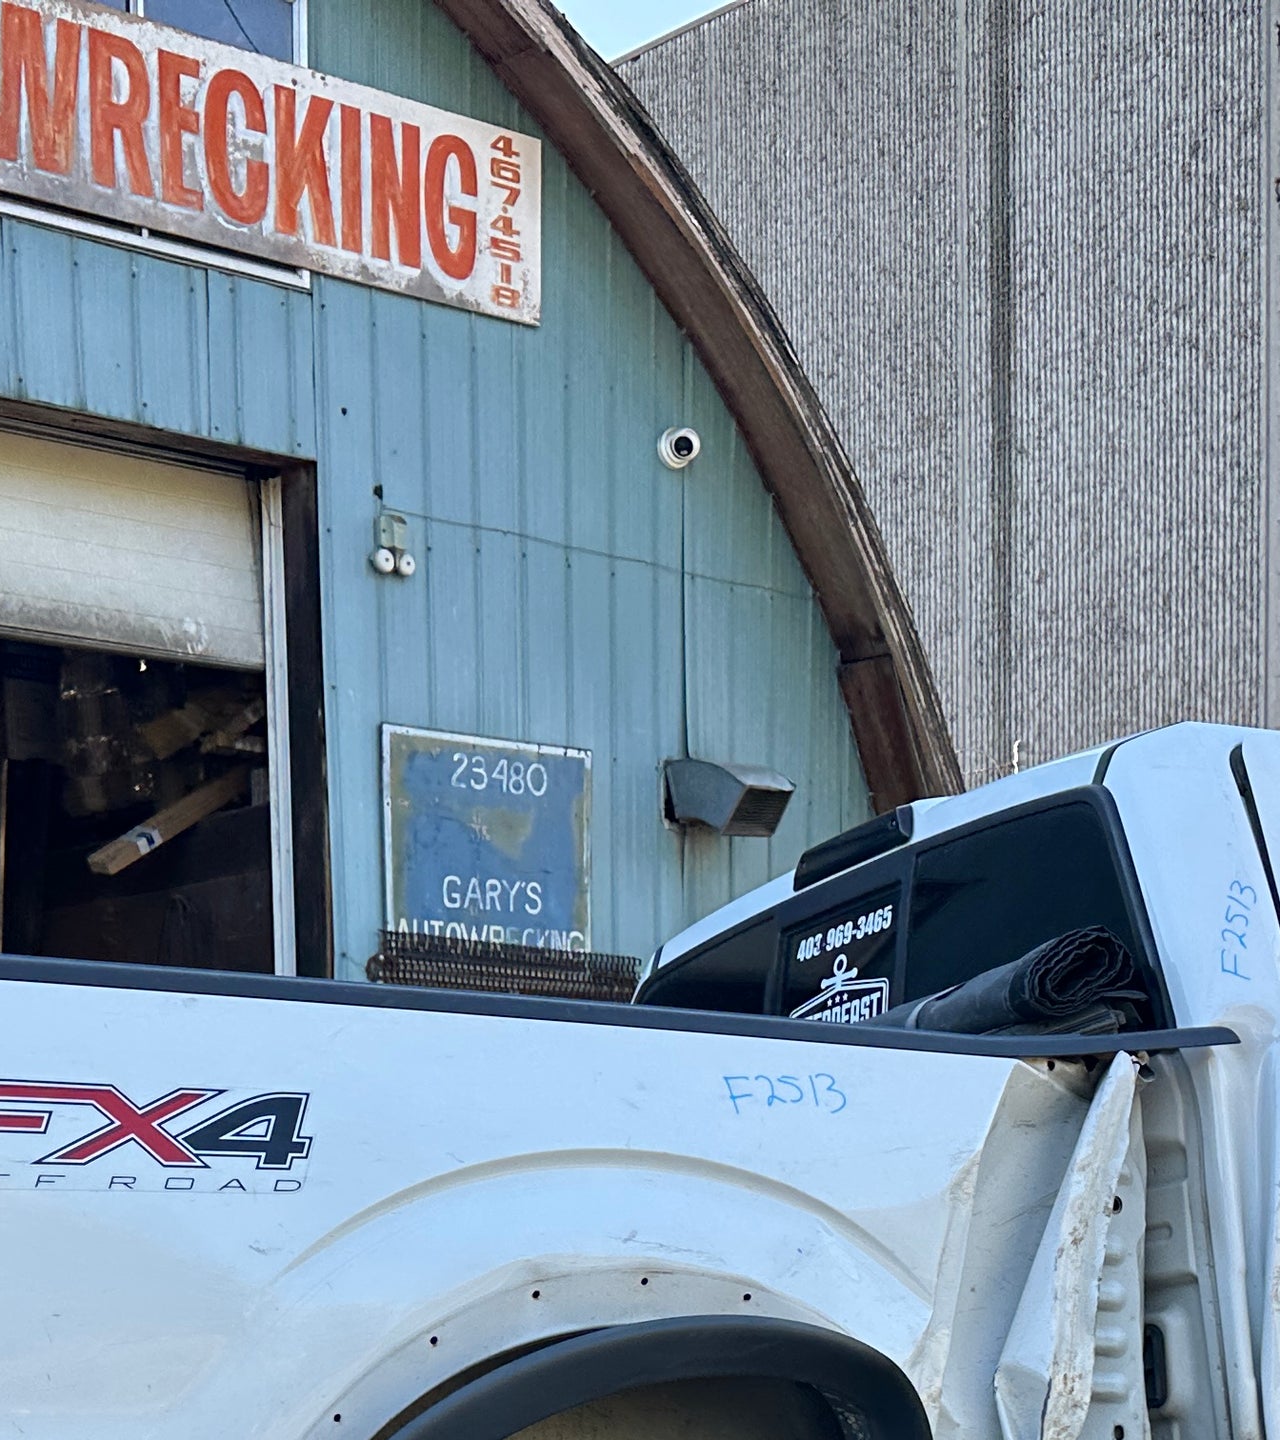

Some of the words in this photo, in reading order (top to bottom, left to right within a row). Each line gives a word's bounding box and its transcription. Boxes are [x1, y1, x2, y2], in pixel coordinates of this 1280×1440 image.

[450, 751, 549, 798] 23480
[442, 874, 543, 916] GARY'S
[796, 904, 894, 963] 403-969-3465
[1220, 879, 1258, 981] F2513
[722, 1072, 847, 1115] F2513
